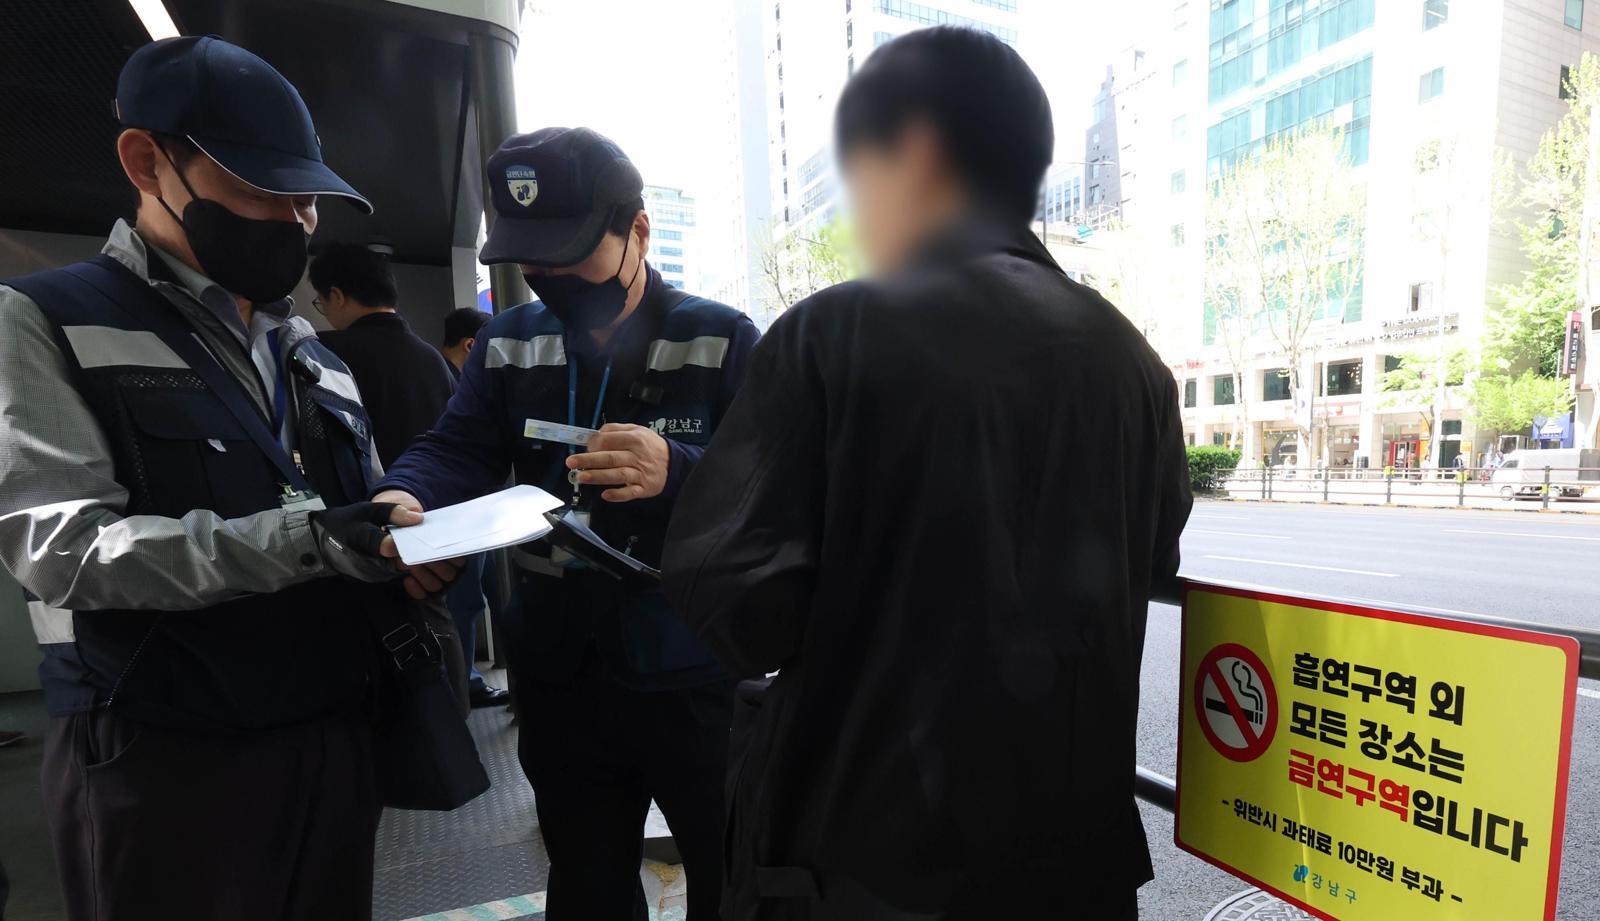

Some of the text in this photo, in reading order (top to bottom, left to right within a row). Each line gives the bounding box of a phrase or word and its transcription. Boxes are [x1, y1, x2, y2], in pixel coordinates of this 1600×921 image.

[667, 418, 702, 429] 강남구
[1292, 652, 1465, 726] 흡연구역 외
[1290, 700, 1465, 784] 모든 장소는
[1288, 749, 1529, 863] 금연구역입니다
[1233, 798, 1278, 833] 위반시
[1282, 816, 1332, 857] 과태료
[1337, 841, 1394, 882] 10만원
[1400, 870, 1444, 902] 부과
[1311, 872, 1357, 904] 강남구
